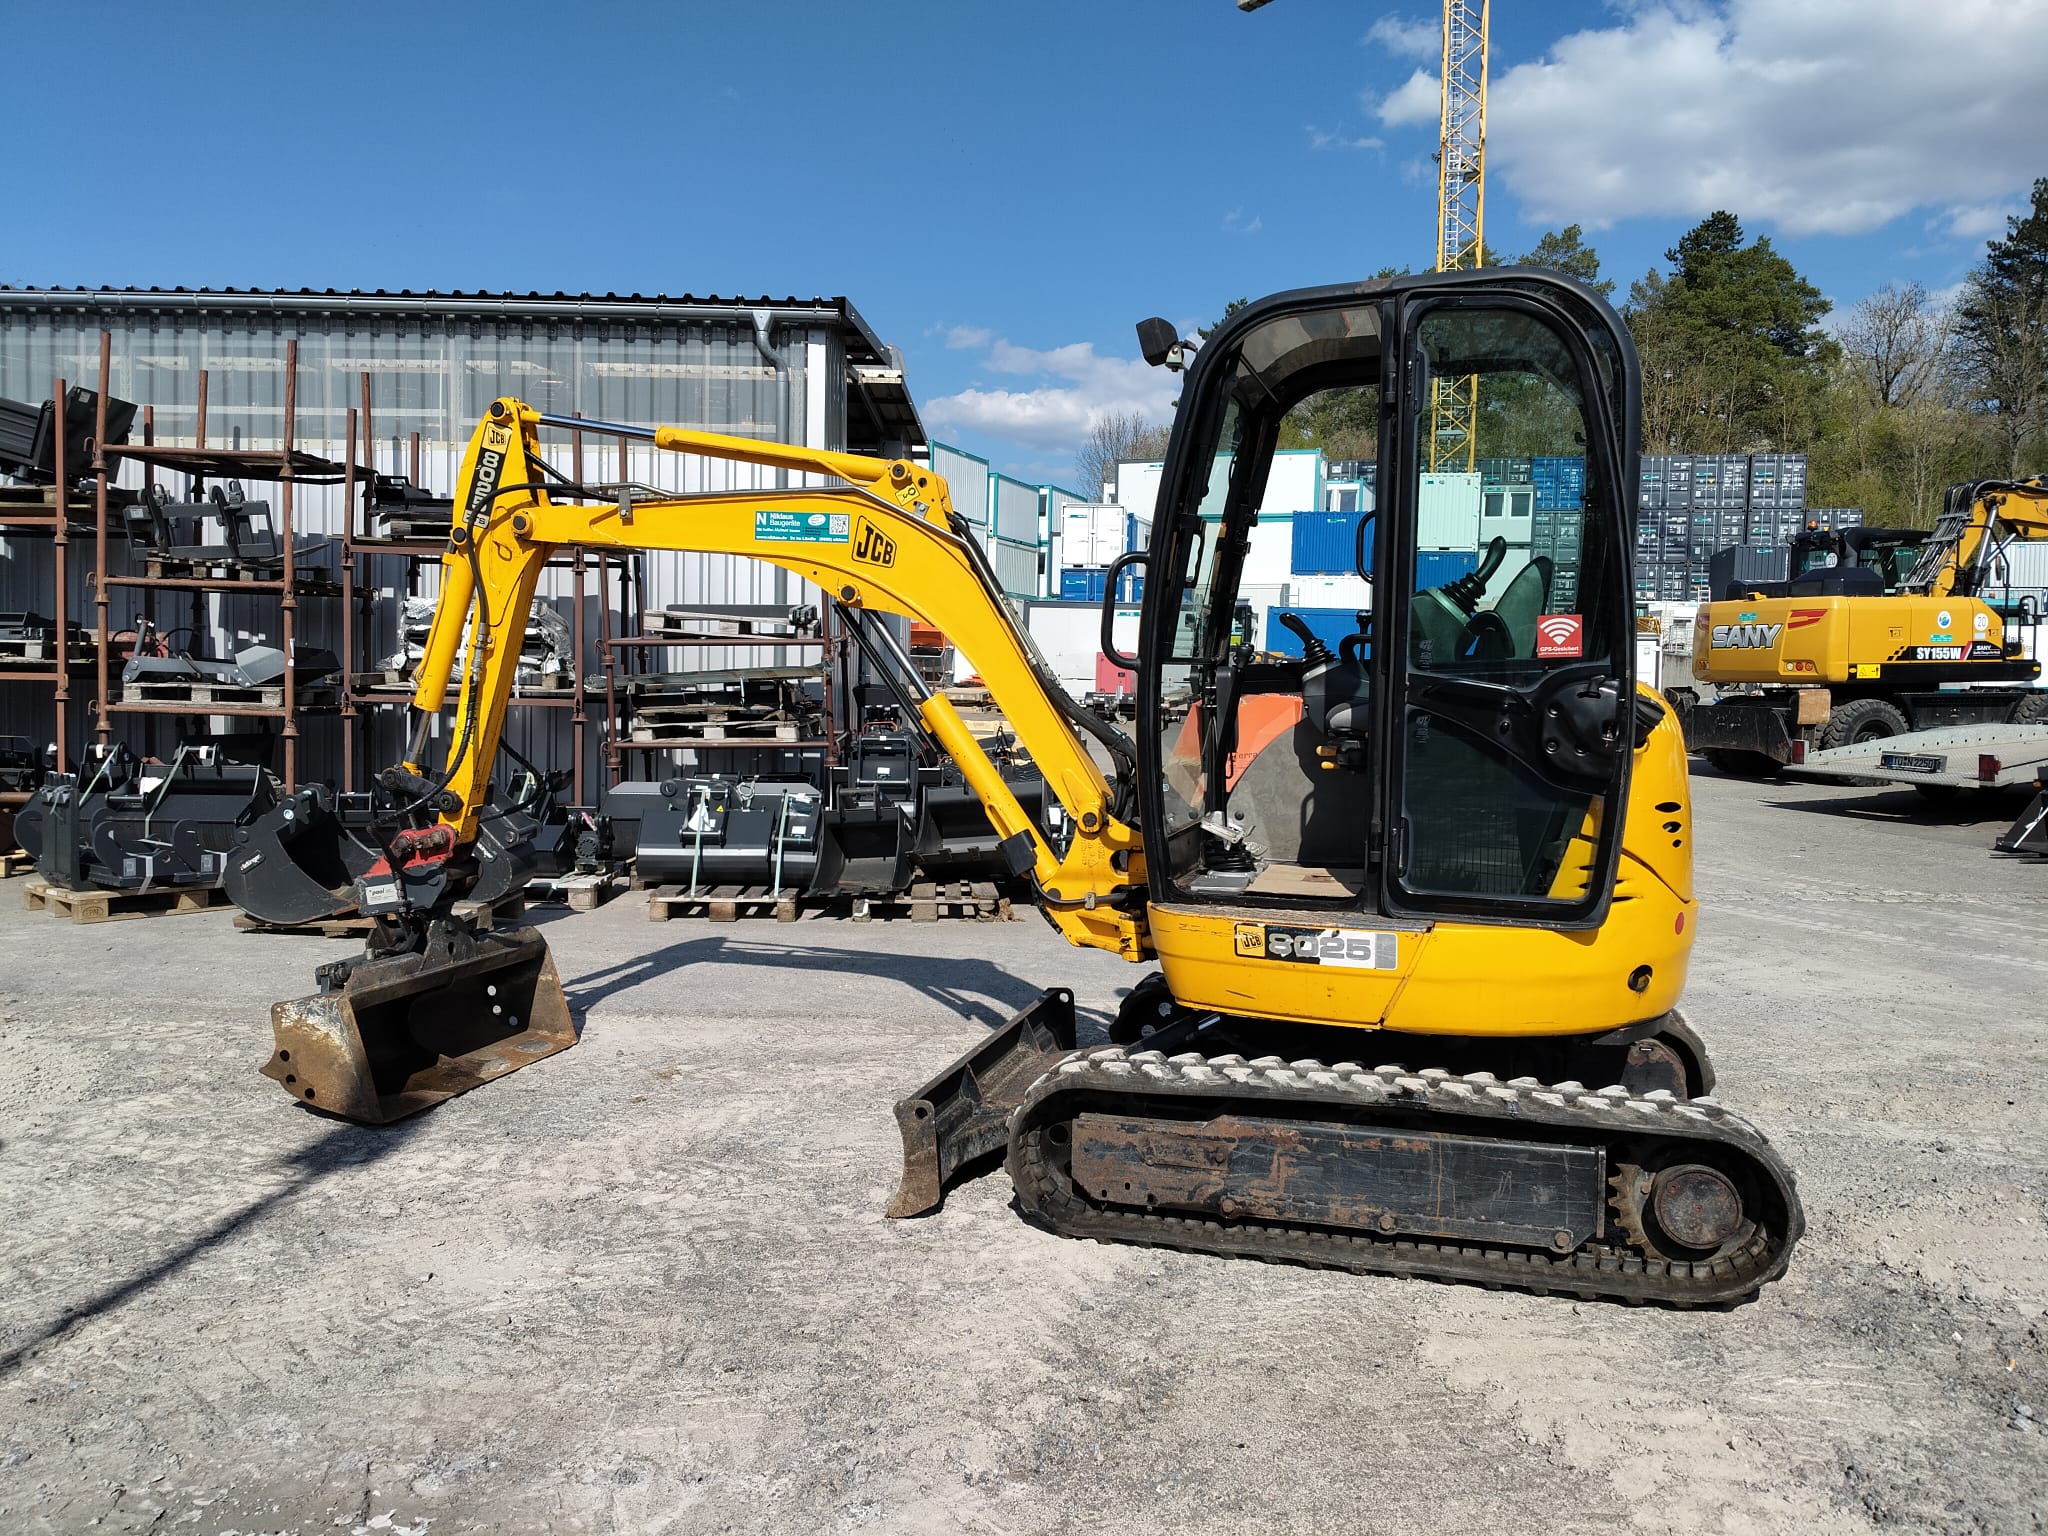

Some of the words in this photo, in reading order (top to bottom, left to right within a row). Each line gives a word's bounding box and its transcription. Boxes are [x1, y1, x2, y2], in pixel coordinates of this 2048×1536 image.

[489, 429, 505, 444] JCB
[855, 523, 894, 564] JCB
[1977, 616, 1987, 628] 20
[1711, 623, 1784, 649] SANY
[1916, 647, 1962, 660] SY155W
[1243, 931, 1262, 948] JCB
[1268, 932, 1371, 960] 8025
